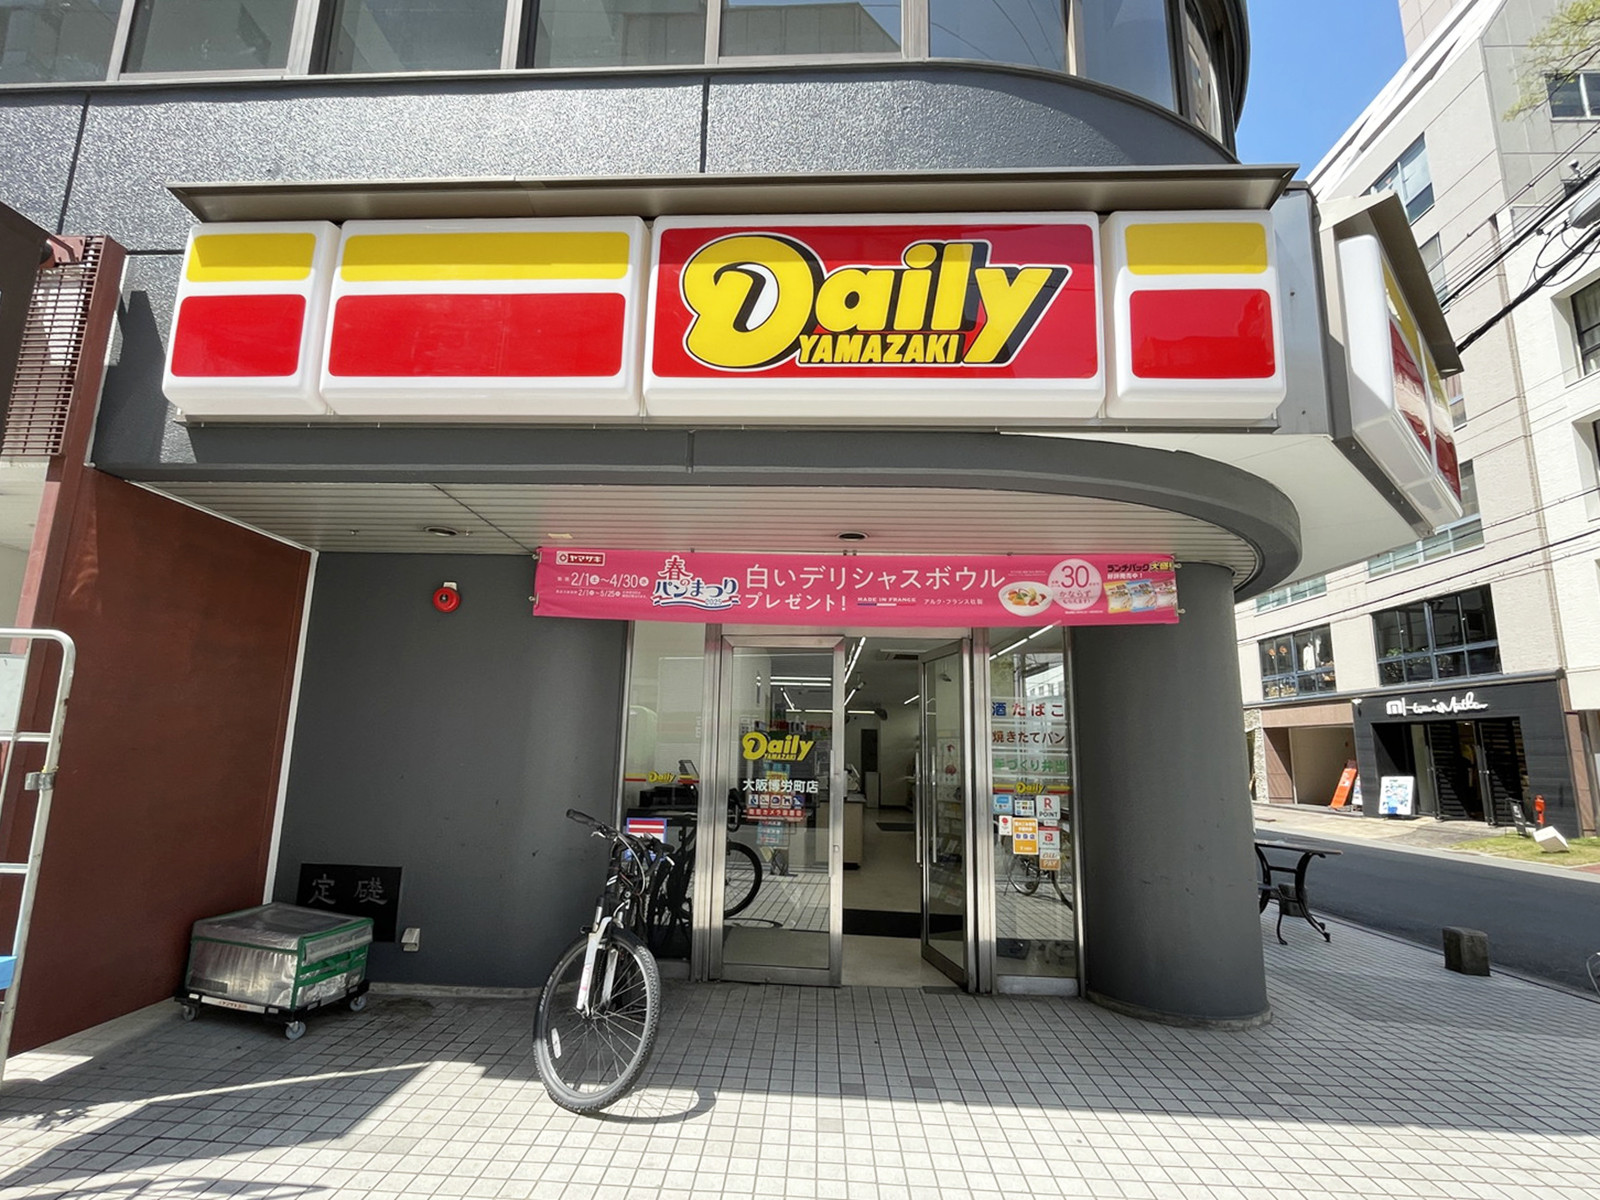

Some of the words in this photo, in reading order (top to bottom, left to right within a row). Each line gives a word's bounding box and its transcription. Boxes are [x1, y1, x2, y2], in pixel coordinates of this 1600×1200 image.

[680, 232, 1072, 371] Daily
[797, 333, 964, 364] YAMAZAKI
[569, 555, 602, 563] ヤマザキ
[746, 564, 1006, 590] 白いデリシャスボウル
[1061, 565, 1089, 588] 30
[654, 578, 737, 598] パンまつり
[745, 591, 847, 612] プレゼント!
[992, 702, 1006, 716] 酒
[1012, 703, 1064, 717] たばこ
[742, 731, 815, 761] Daily
[992, 730, 1065, 743] 焼きたてパン
[648, 770, 676, 783] Daily
[742, 779, 819, 793] 大阪博労町店
[1016, 781, 1047, 793] Daily
[1044, 797, 1052, 808] R
[308, 873, 388, 905] 定礎
